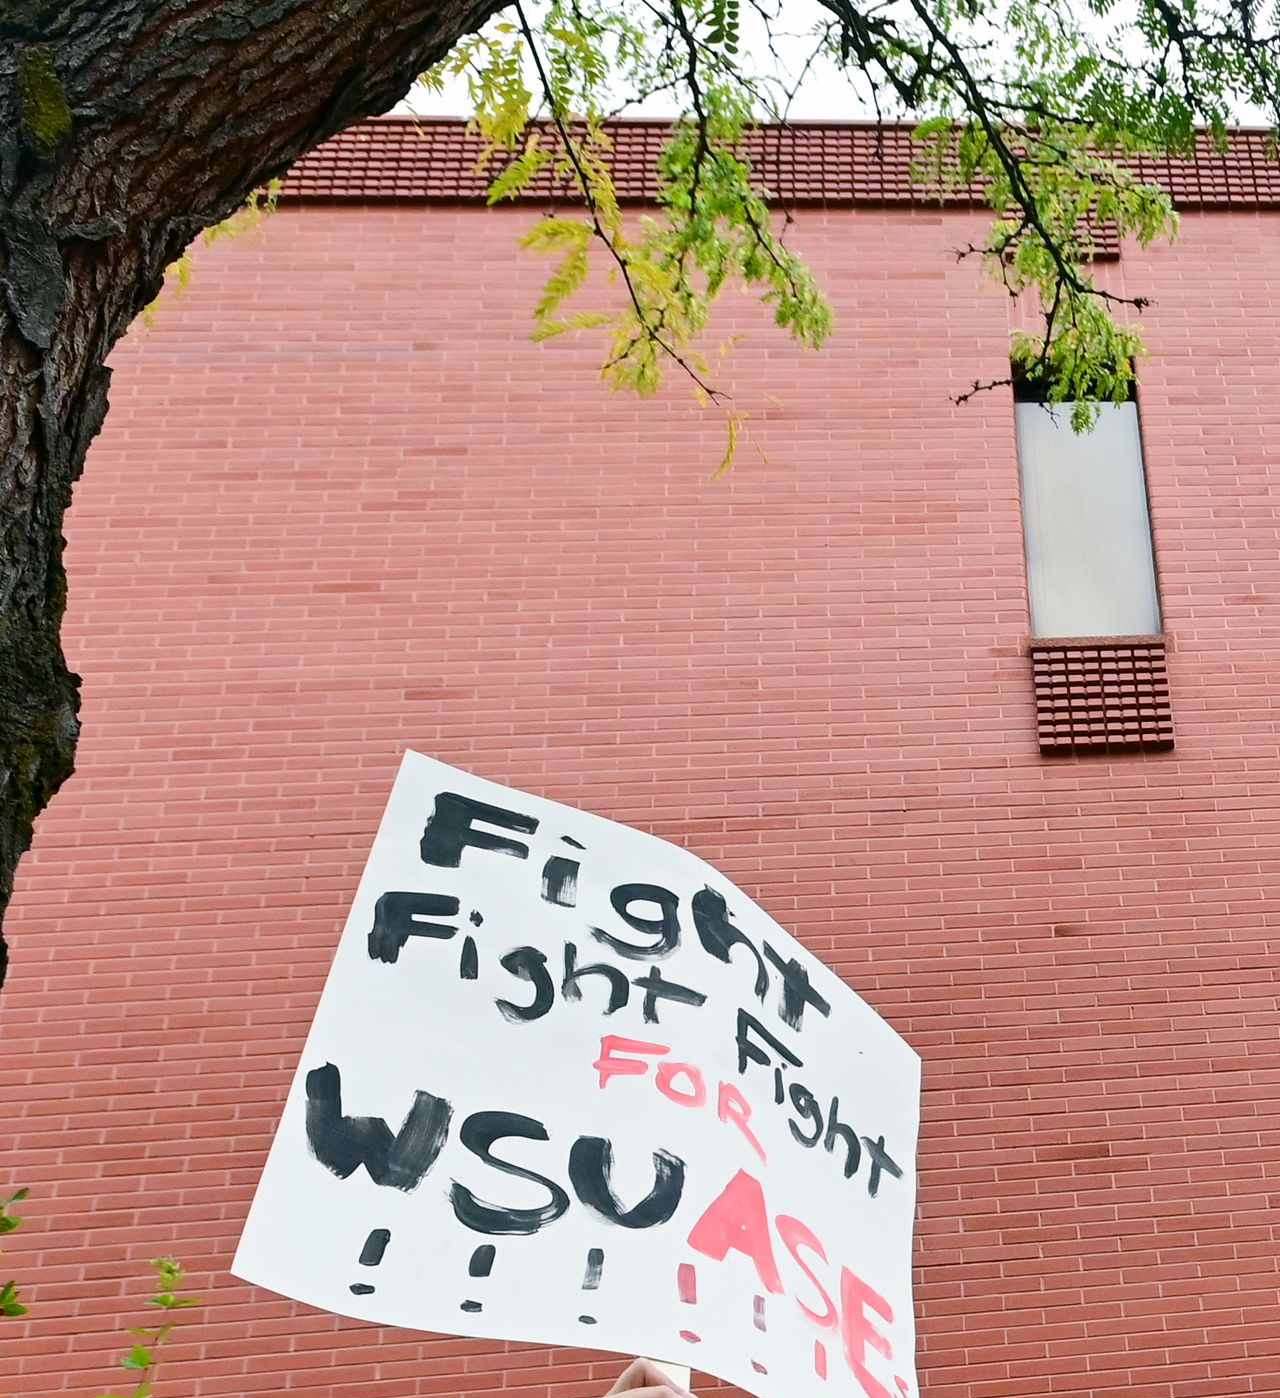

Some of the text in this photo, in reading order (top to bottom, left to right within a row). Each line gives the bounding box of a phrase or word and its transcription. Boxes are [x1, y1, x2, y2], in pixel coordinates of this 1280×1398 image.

[420, 792, 831, 1032] Fight
[367, 890, 904, 1198] Fight Fight
[592, 1034, 767, 1162] FOR
[305, 1061, 687, 1236] WSU
